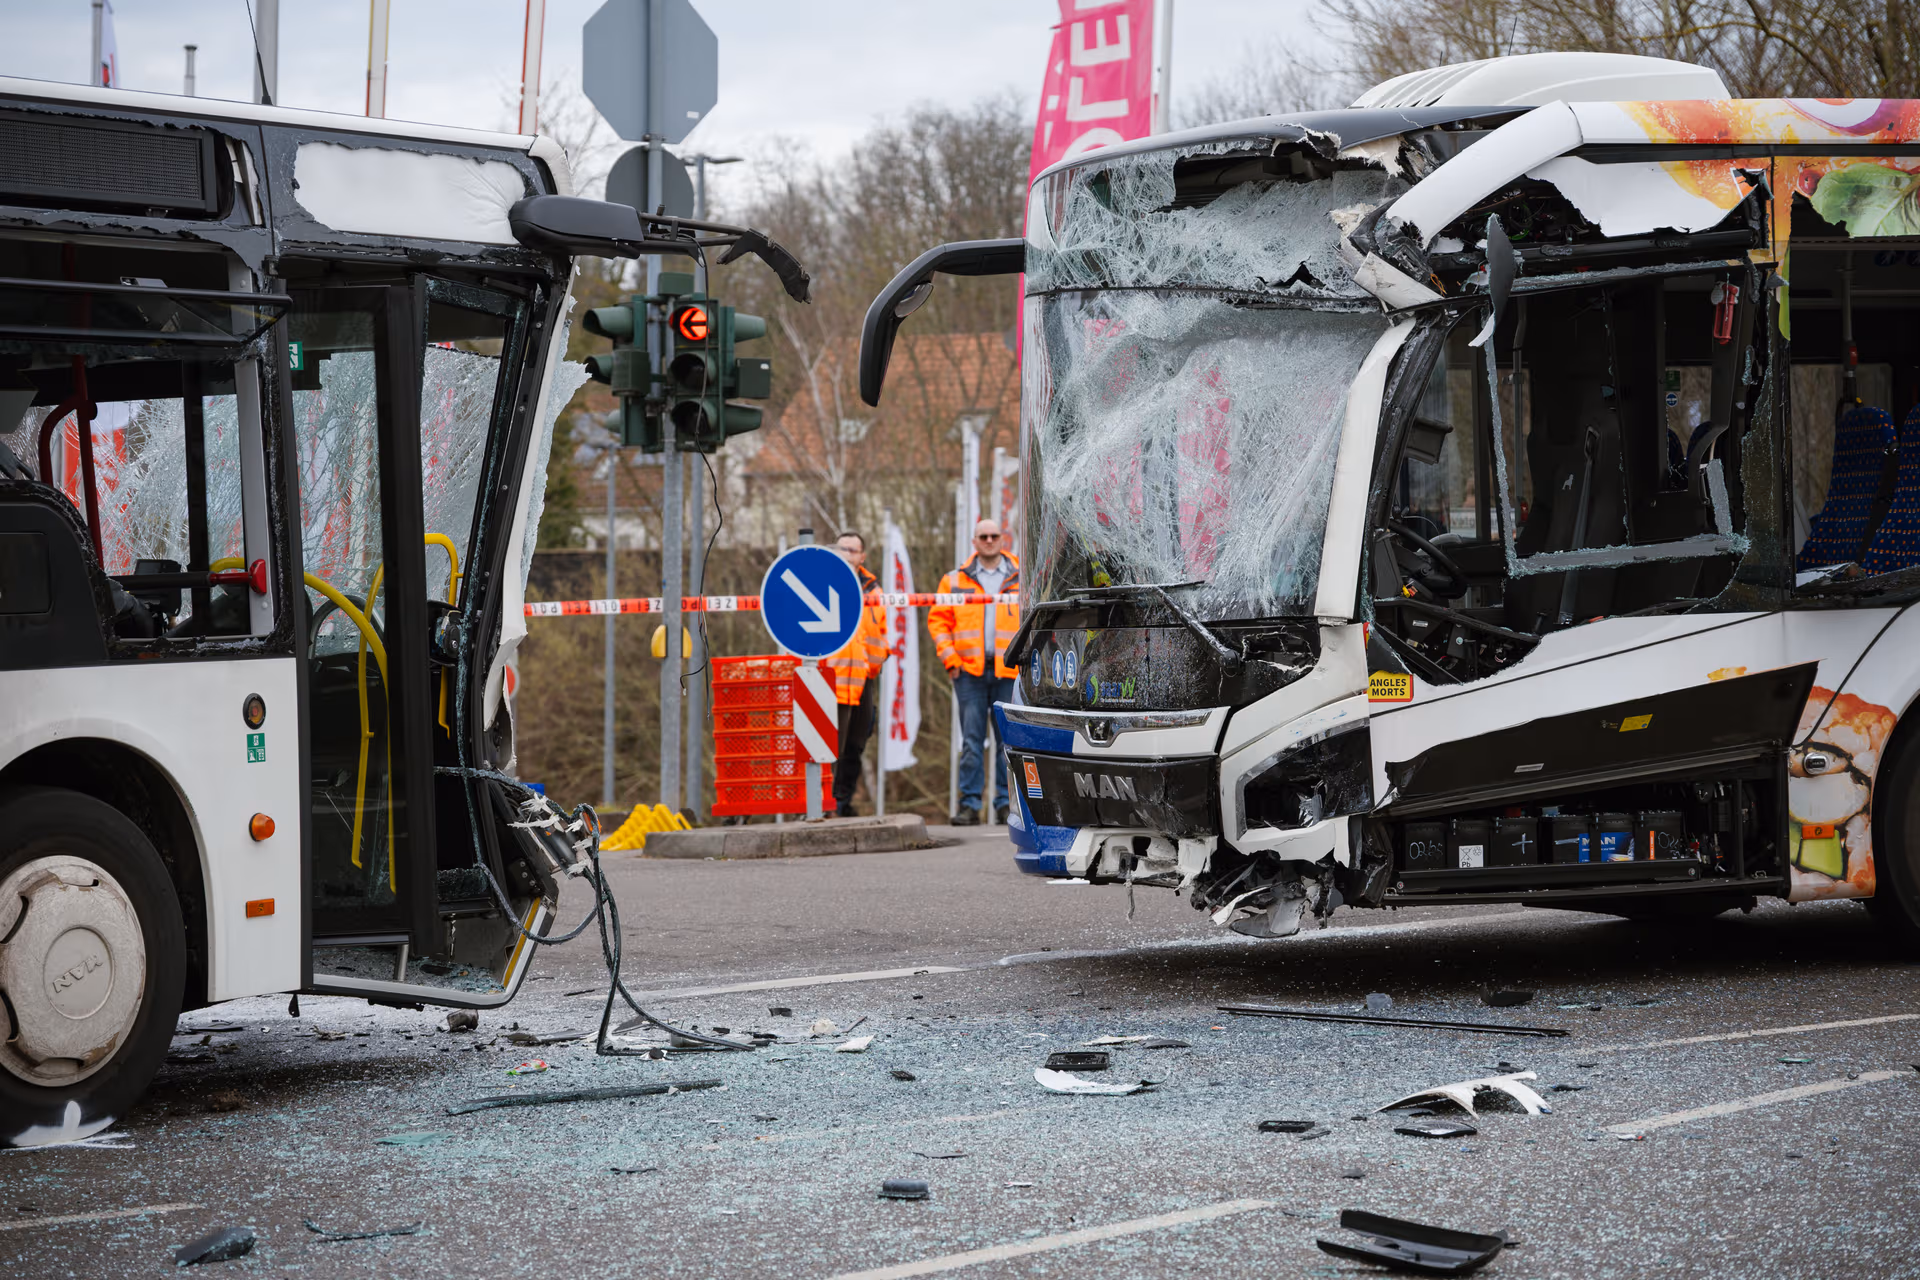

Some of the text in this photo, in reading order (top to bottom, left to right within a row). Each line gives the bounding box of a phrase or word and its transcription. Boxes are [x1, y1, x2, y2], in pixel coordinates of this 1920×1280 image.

[566, 600, 628, 613] POLIZEI
[1368, 678, 1407, 687] ANGLES
[1371, 687, 1406, 696] MORTS
[1073, 772, 1138, 802] MAN
[52, 954, 103, 994] MAN
